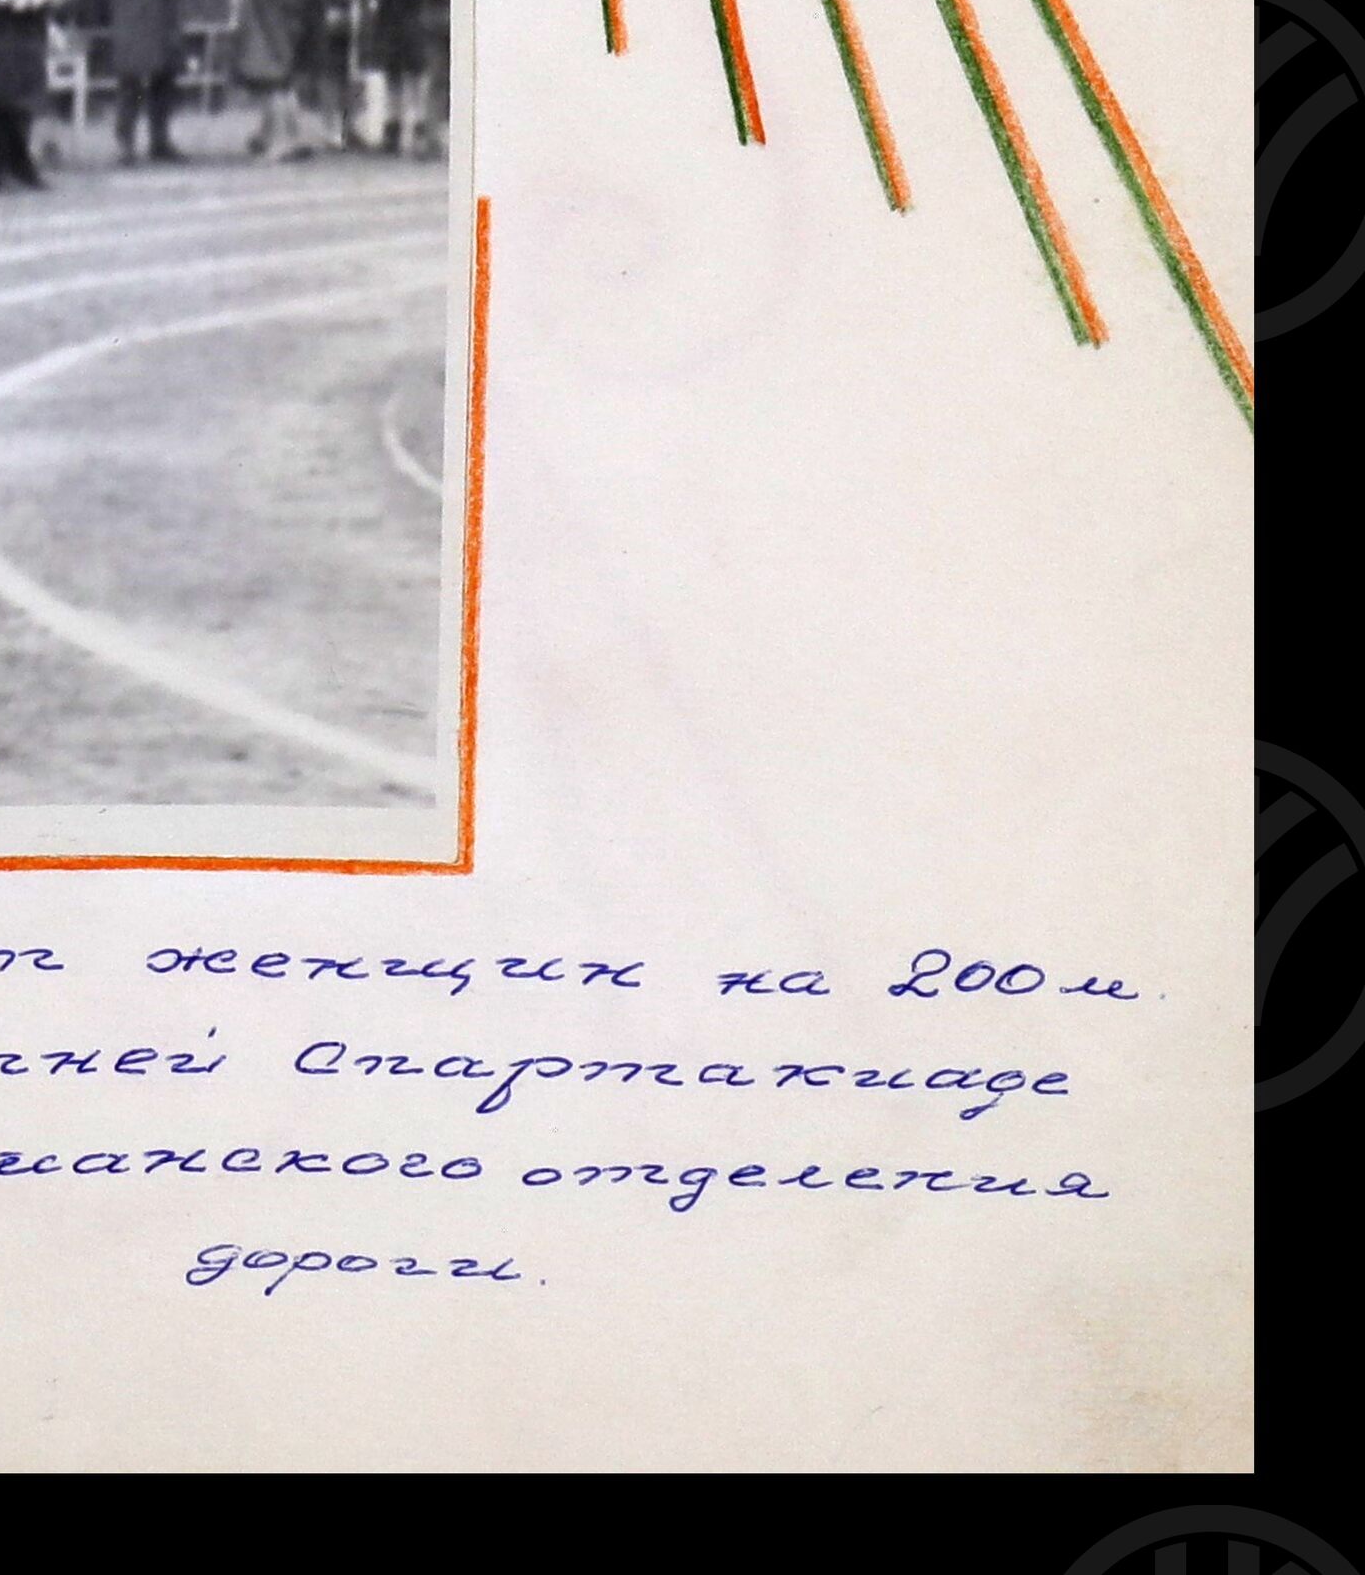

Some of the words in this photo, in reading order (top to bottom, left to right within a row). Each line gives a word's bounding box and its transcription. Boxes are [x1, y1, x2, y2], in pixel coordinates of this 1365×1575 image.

[146, 947, 645, 997] женщин
[717, 970, 831, 997] на
[522, 1164, 1110, 1213] отделения
[186, 1245, 548, 1296] дороги.
